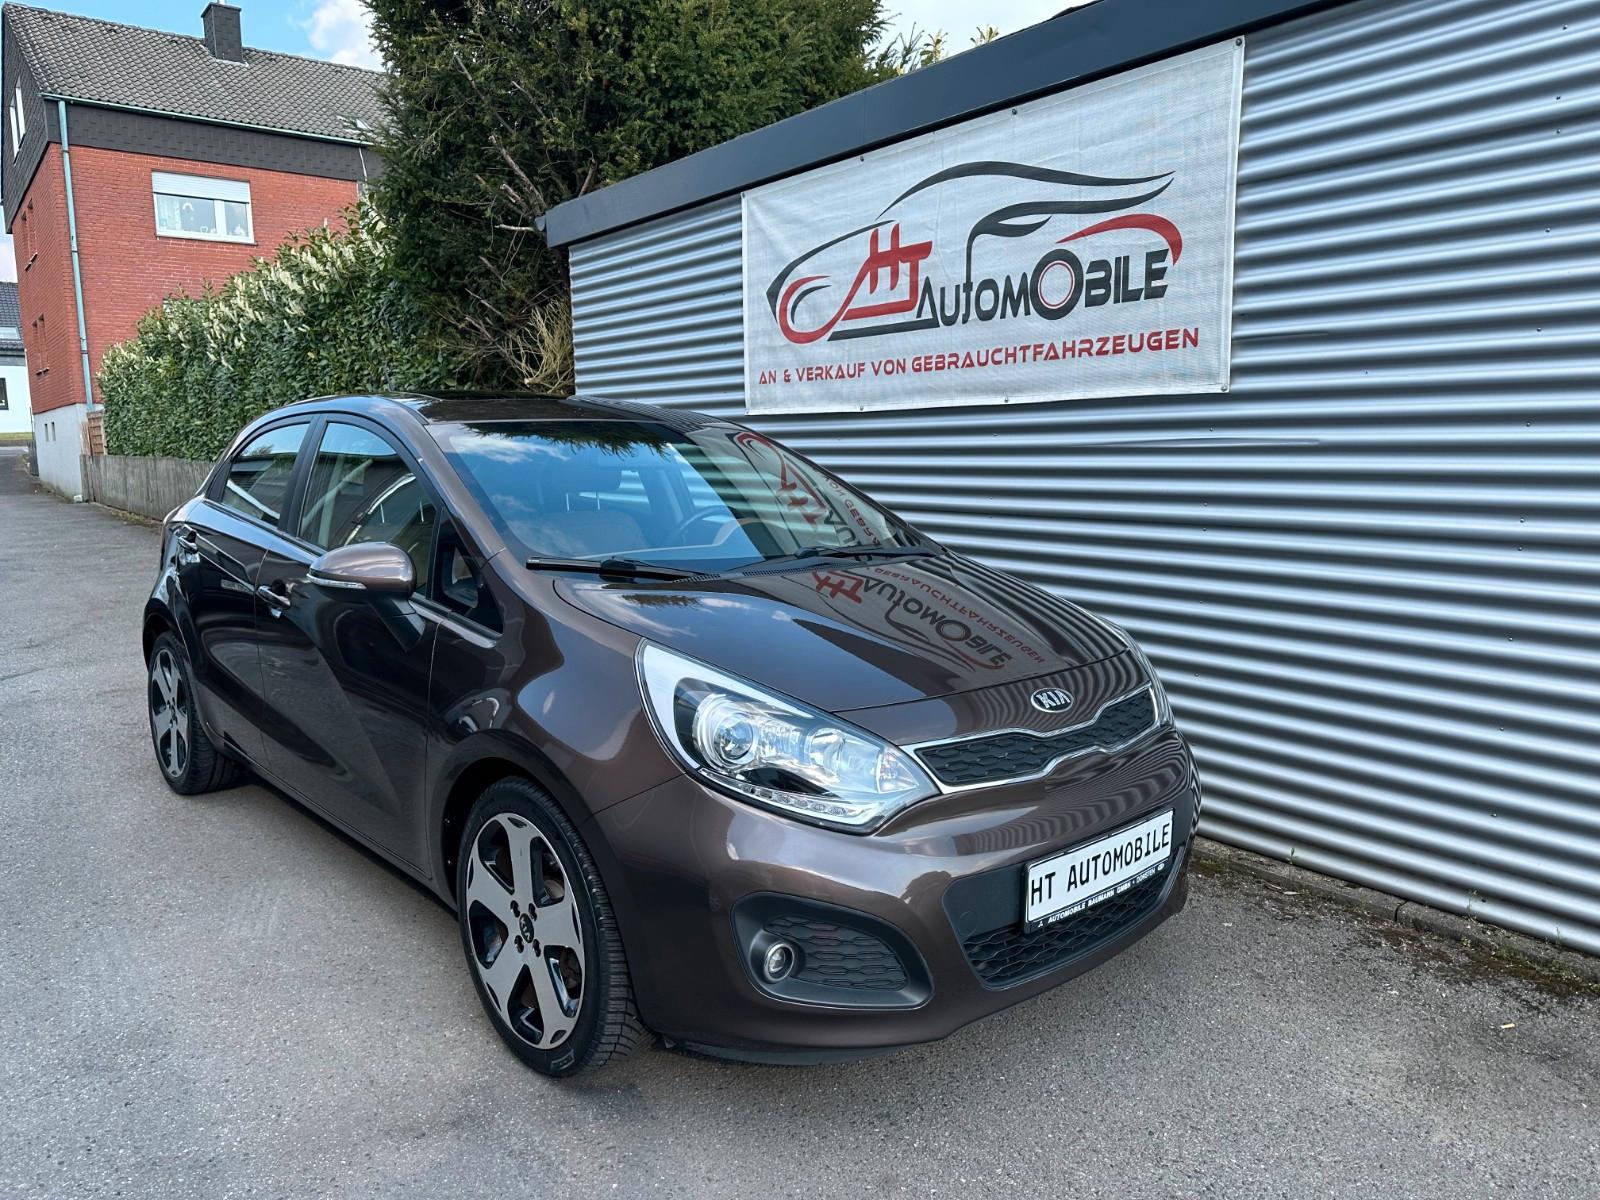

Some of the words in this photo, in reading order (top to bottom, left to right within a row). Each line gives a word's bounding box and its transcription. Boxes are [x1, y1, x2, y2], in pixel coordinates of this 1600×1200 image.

[916, 249, 1169, 327] AUTOMOBILE
[759, 368, 777, 385] AN
[783, 370, 792, 384] &
[796, 362, 866, 383] VERKAUF
[871, 359, 906, 376] VON
[912, 327, 1200, 373] GEBRAUCHTFAHRZEUGEN
[1036, 690, 1071, 709] KIA
[1031, 871, 1056, 906] HT
[1067, 823, 1170, 892] AUTOMOBILE
[1048, 902, 1086, 924] AUTOMOBILE
